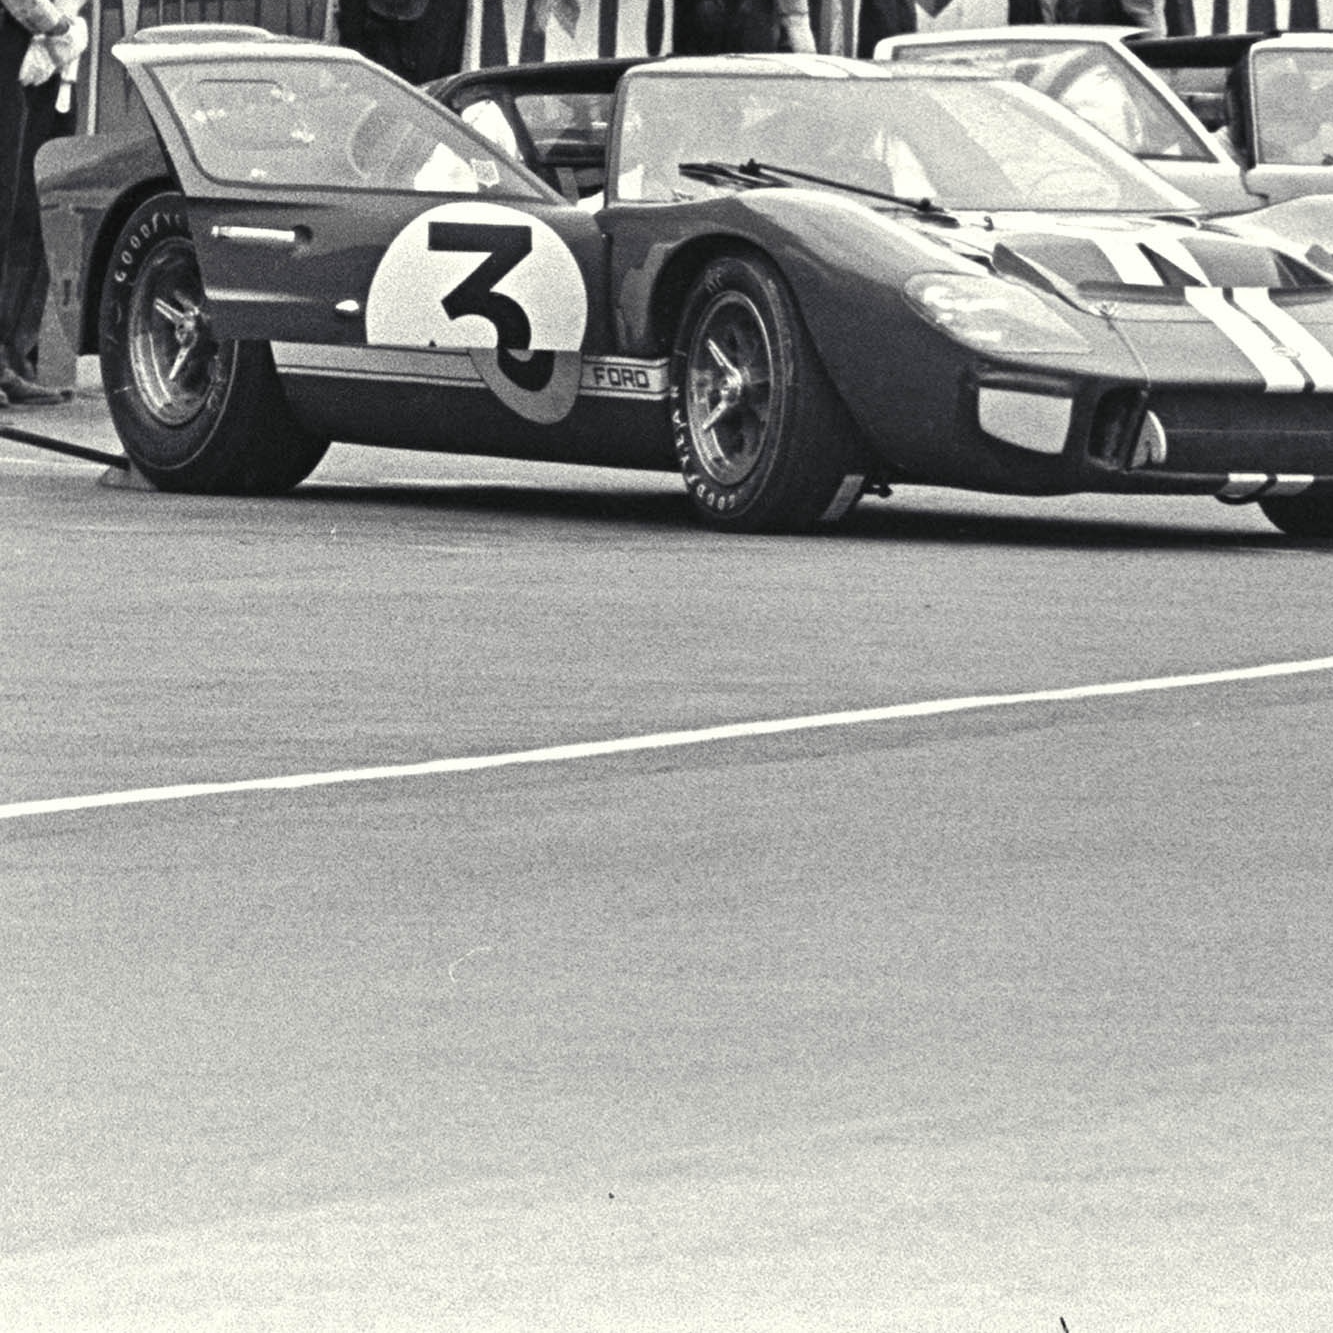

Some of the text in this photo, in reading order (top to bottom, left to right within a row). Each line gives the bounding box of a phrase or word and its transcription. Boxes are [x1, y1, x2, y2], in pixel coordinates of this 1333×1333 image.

[114, 212, 182, 283] GOODY
[428, 221, 556, 392] 3
[593, 366, 650, 388] FORD
